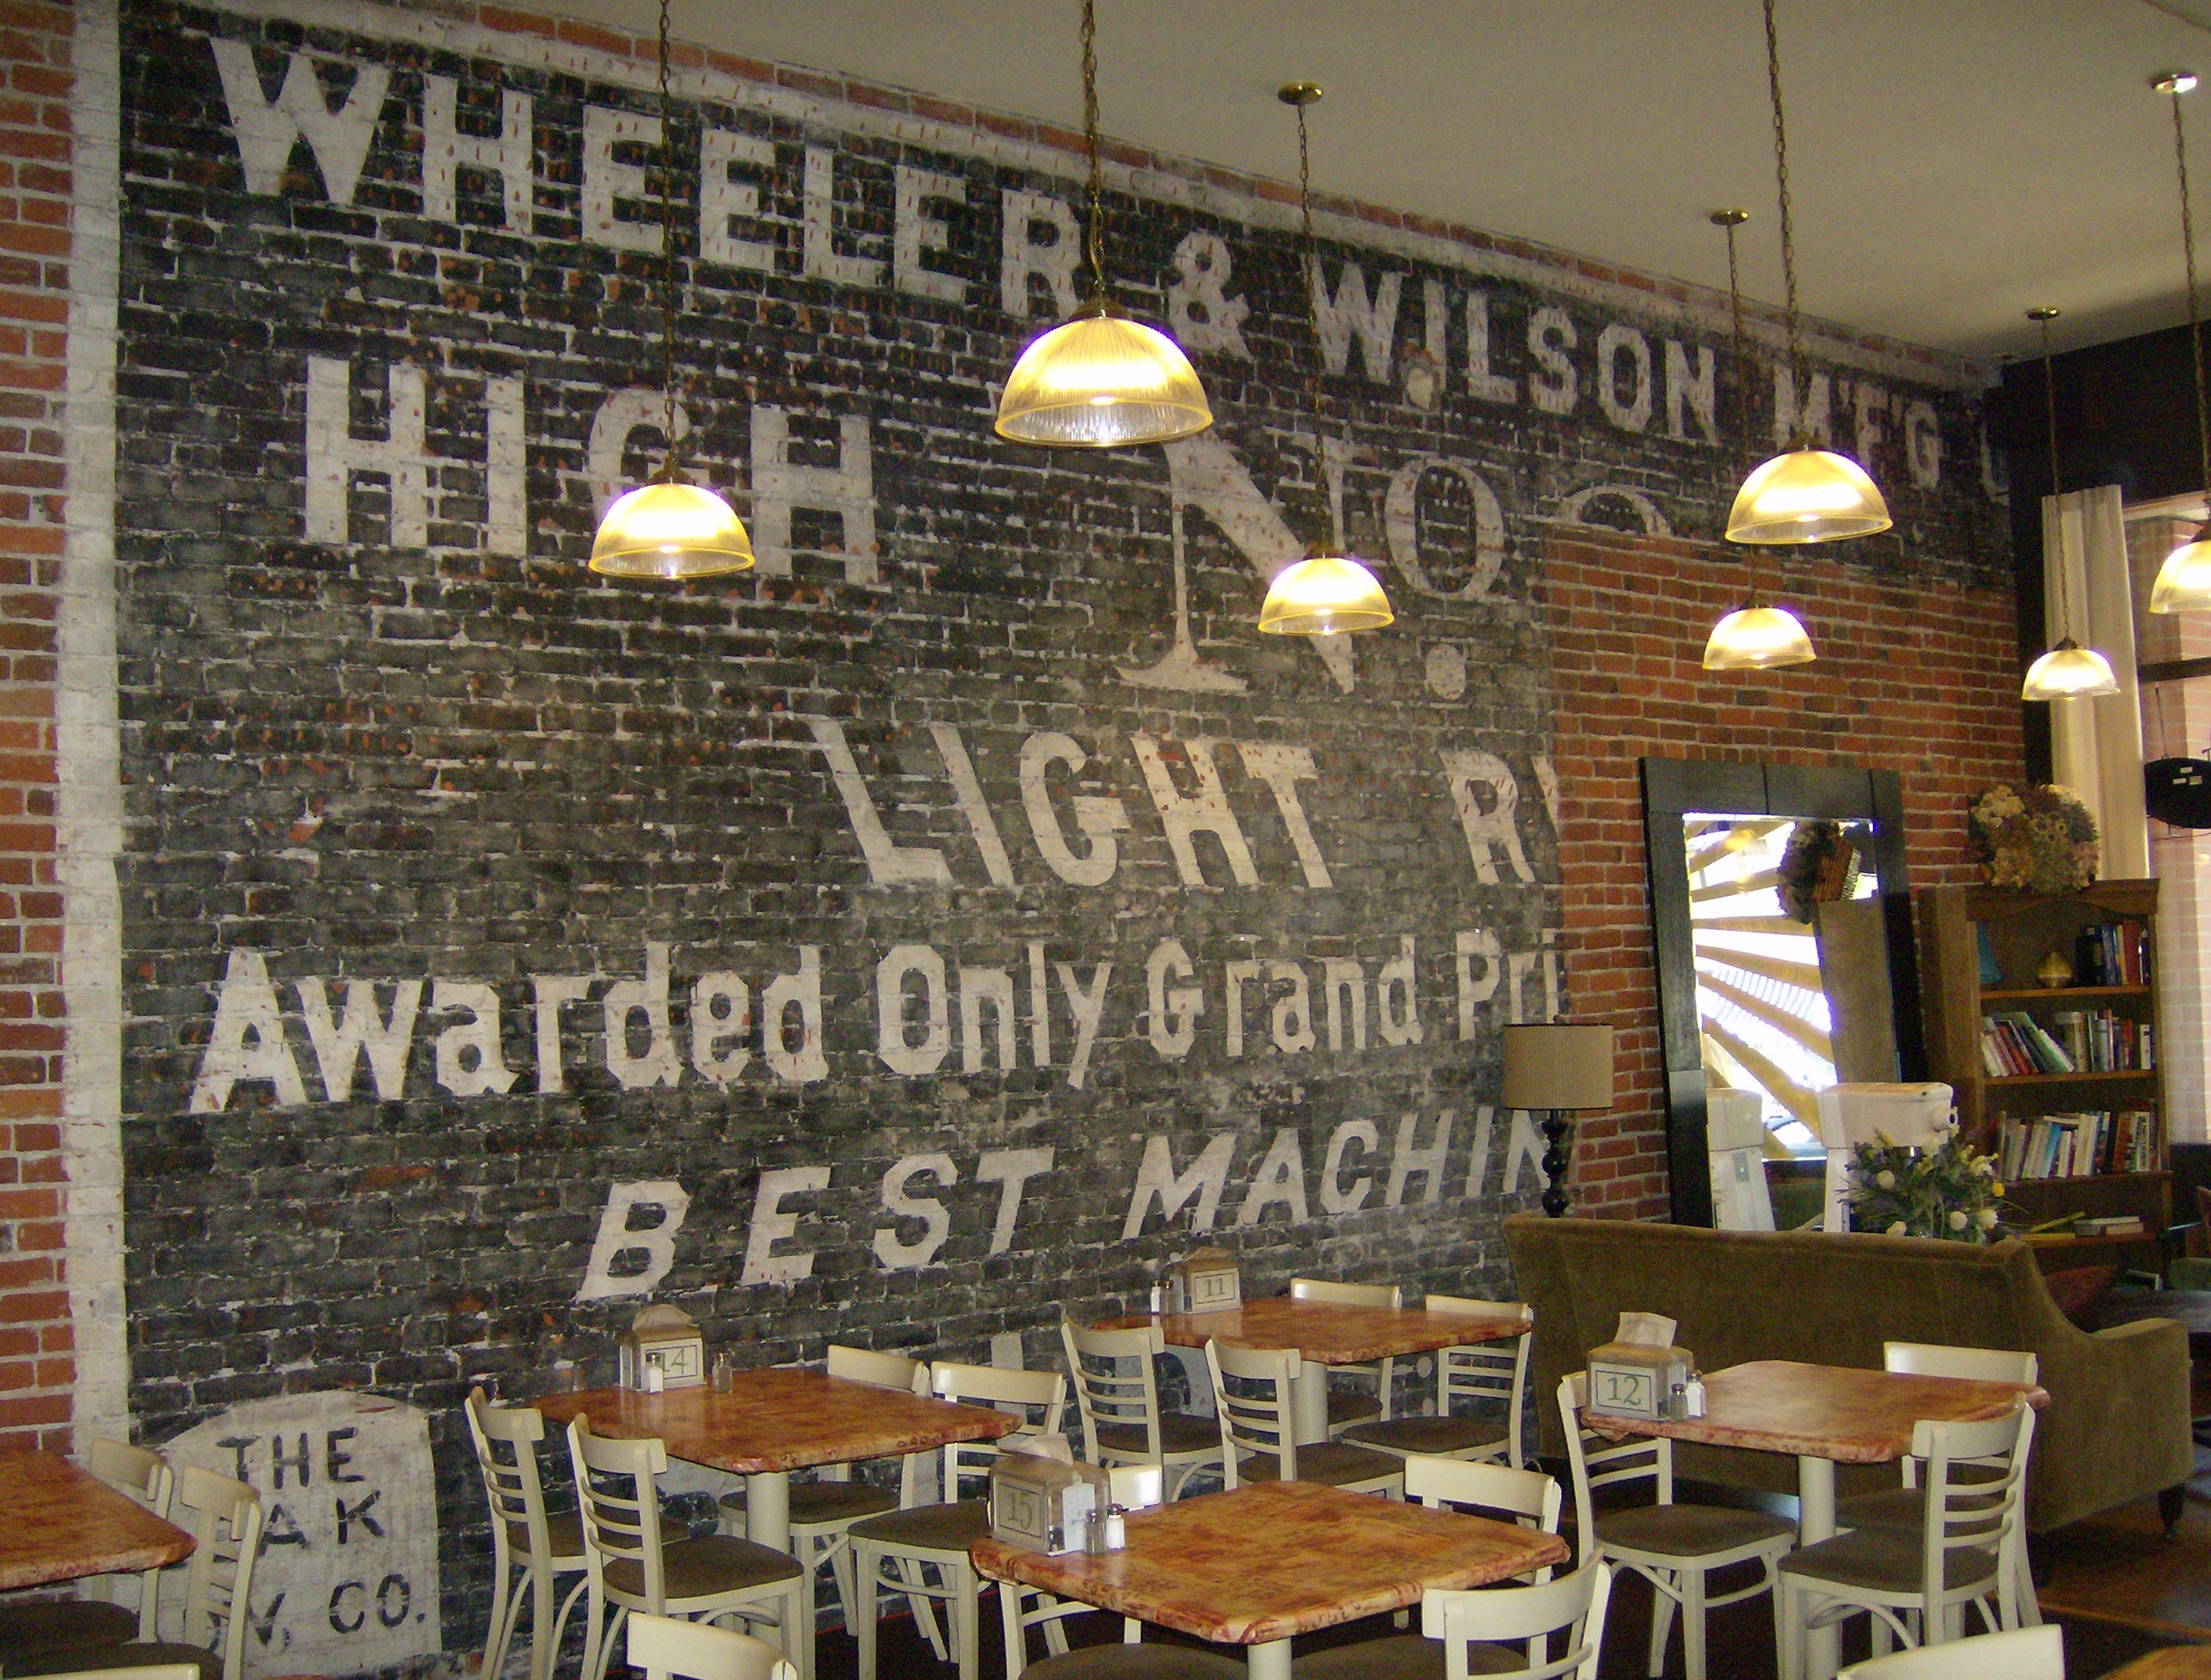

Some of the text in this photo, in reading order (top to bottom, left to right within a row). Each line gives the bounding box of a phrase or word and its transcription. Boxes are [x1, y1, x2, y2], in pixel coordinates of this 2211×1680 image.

[205, 35, 1084, 320] WHEELER
[1169, 229, 1257, 366] &
[1299, 251, 1719, 447] WILSON
[812, 721, 1333, 888] LIGHT
[877, 941, 1112, 1089] Only
[1147, 934, 1424, 1058] Grand
[575, 1146, 1056, 1302] BEST
[1203, 1278, 1226, 1298] 11
[1607, 1374, 1642, 1406] 12
[216, 1426, 366, 1491] THE
[1007, 1491, 1034, 1530] 15
